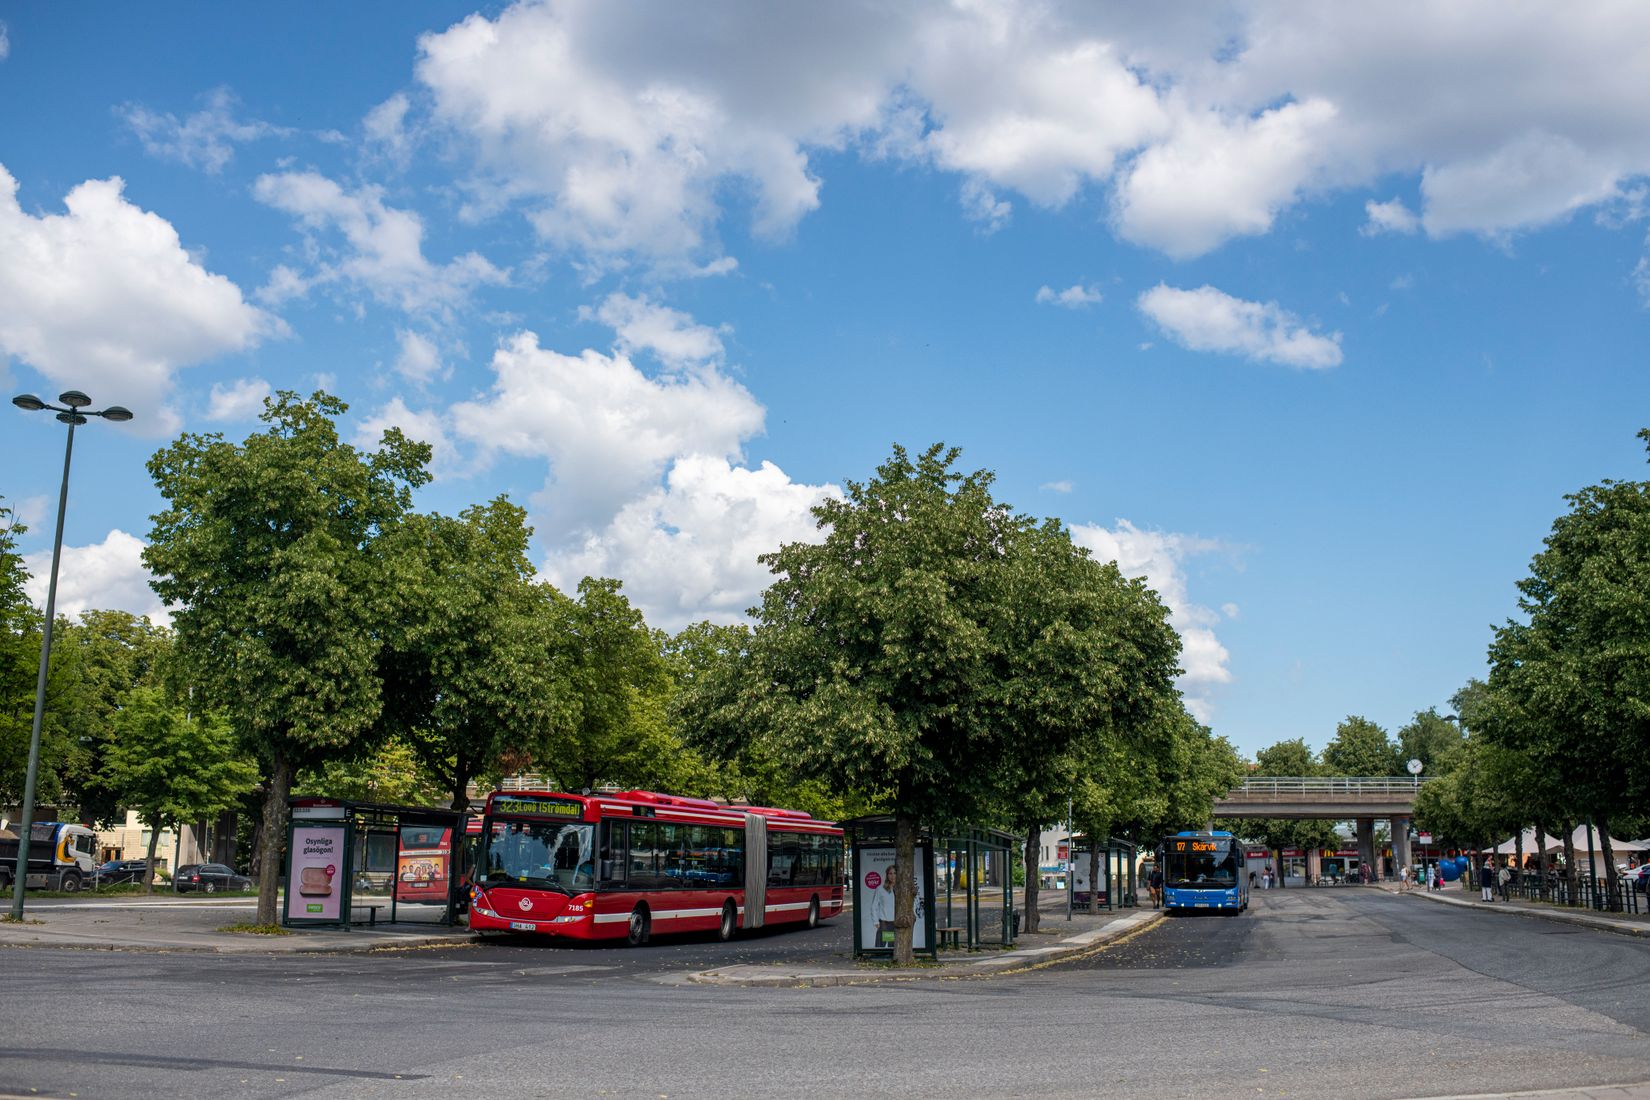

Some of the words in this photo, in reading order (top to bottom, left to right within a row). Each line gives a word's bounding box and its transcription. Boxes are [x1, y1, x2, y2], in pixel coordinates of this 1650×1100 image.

[500, 800, 519, 813] 323
[519, 800, 536, 813] Lovö
[539, 801, 580, 816] (Strömdal)
[345, 809, 352, 817] E
[305, 837, 333, 847] Osynliga
[1176, 842, 1186, 851] 177
[303, 846, 334, 855] glasögon!
[568, 904, 584, 912] 7185
